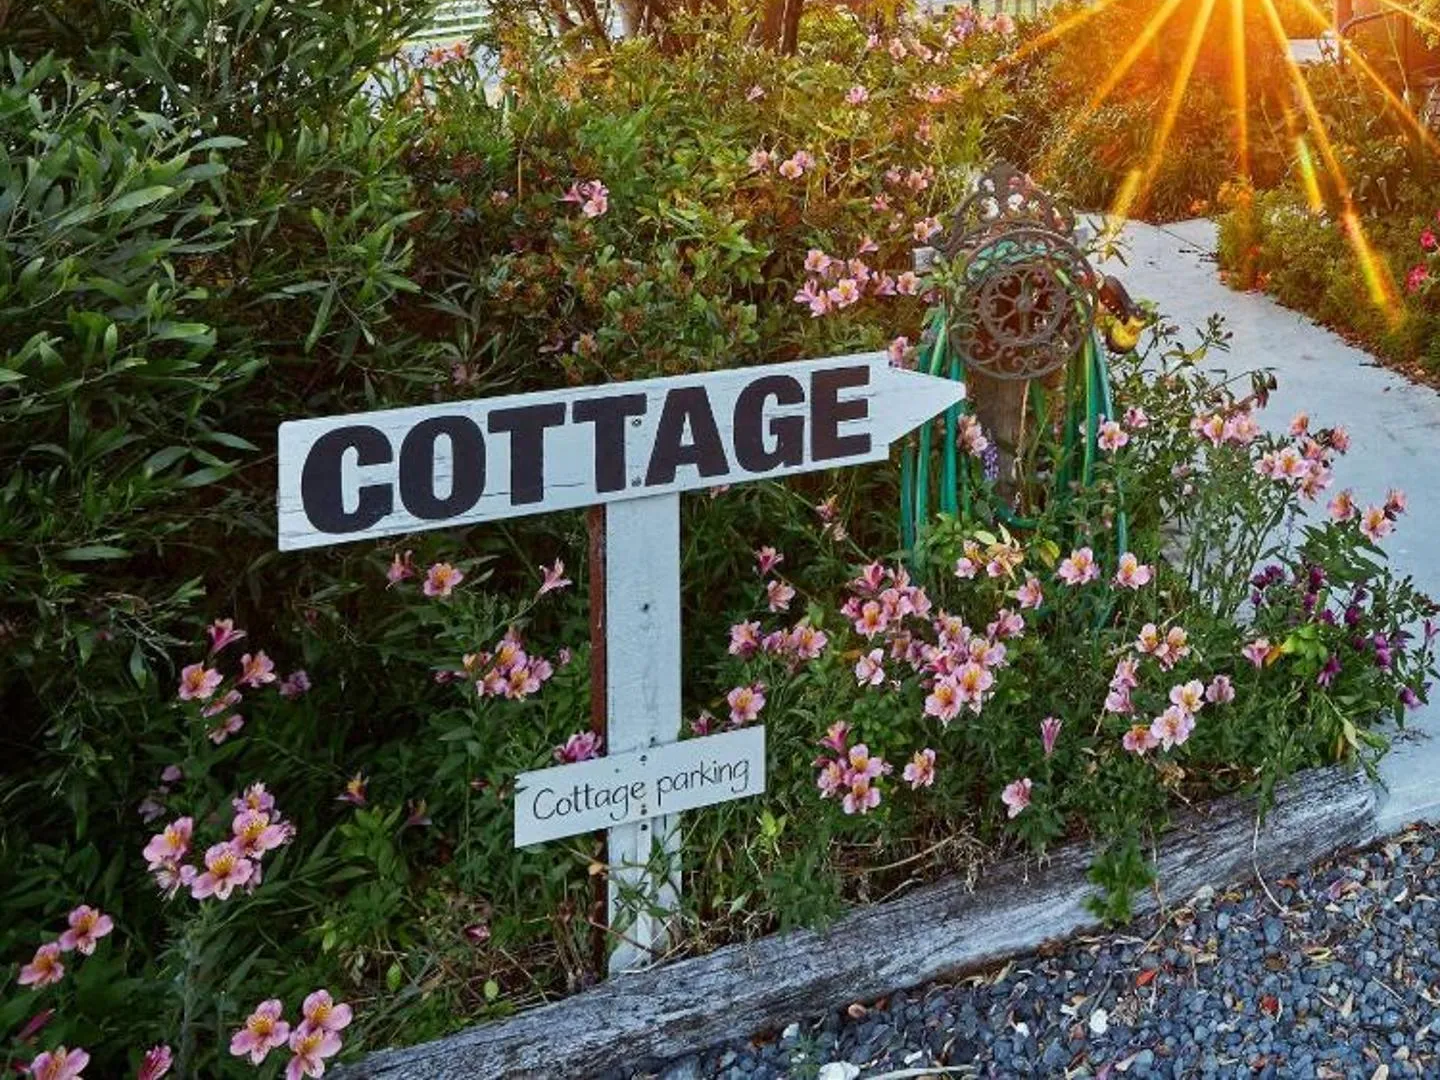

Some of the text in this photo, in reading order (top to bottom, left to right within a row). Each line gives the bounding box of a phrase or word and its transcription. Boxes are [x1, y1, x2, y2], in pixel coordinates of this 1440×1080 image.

[301, 365, 872, 534] COTTAGE
[533, 759, 750, 822] Cottage parking
